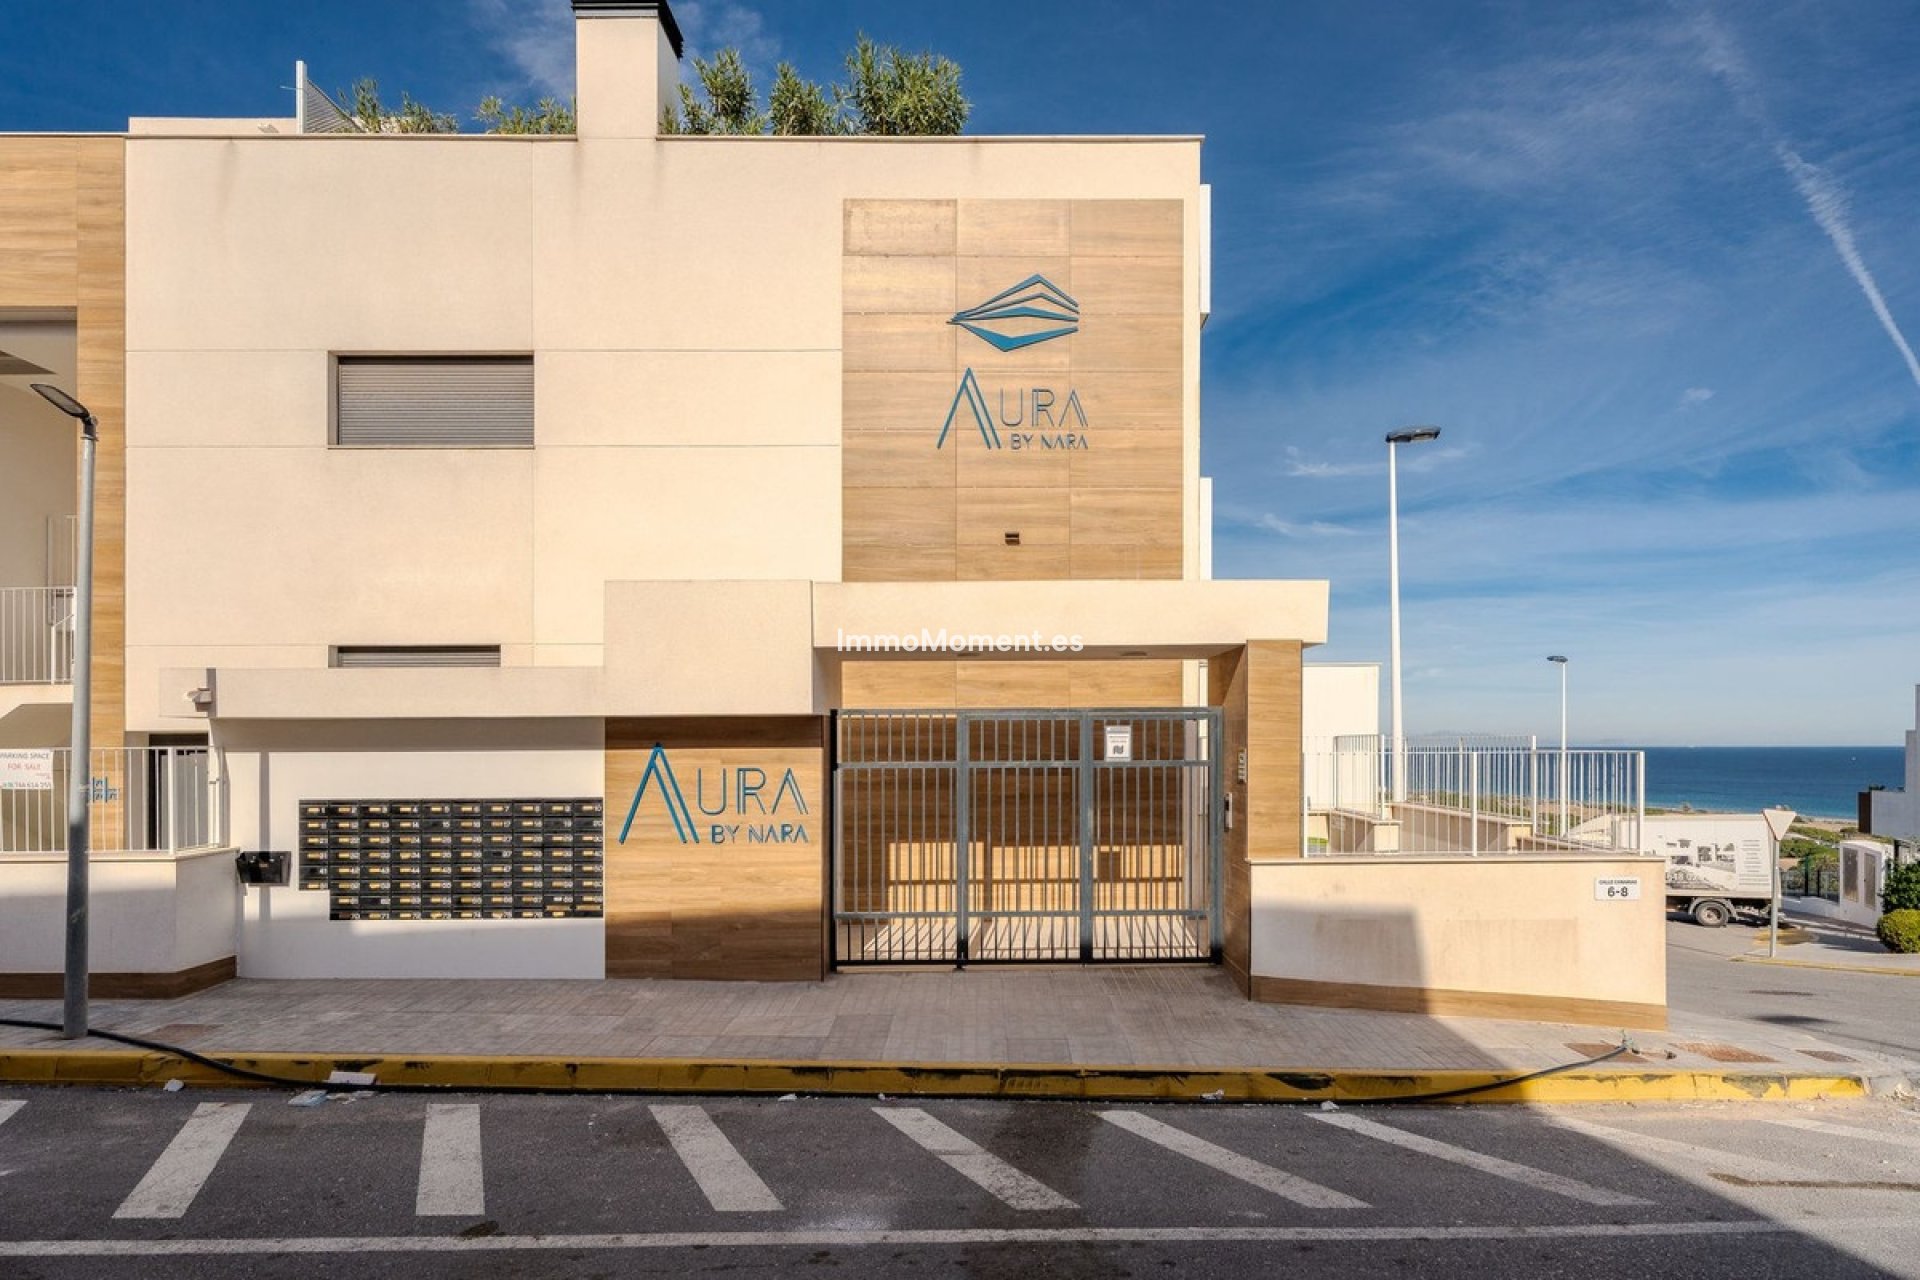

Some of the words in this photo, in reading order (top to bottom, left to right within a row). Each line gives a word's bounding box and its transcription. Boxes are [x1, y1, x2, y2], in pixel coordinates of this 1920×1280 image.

[936, 367, 1089, 449] AURA
[1010, 433, 1034, 450] BY
[1041, 433, 1089, 450] NARA
[618, 742, 809, 845] AURA
[711, 824, 740, 844] BY
[749, 823, 809, 844] NARA
[1607, 886, 1628, 897] 6-8
